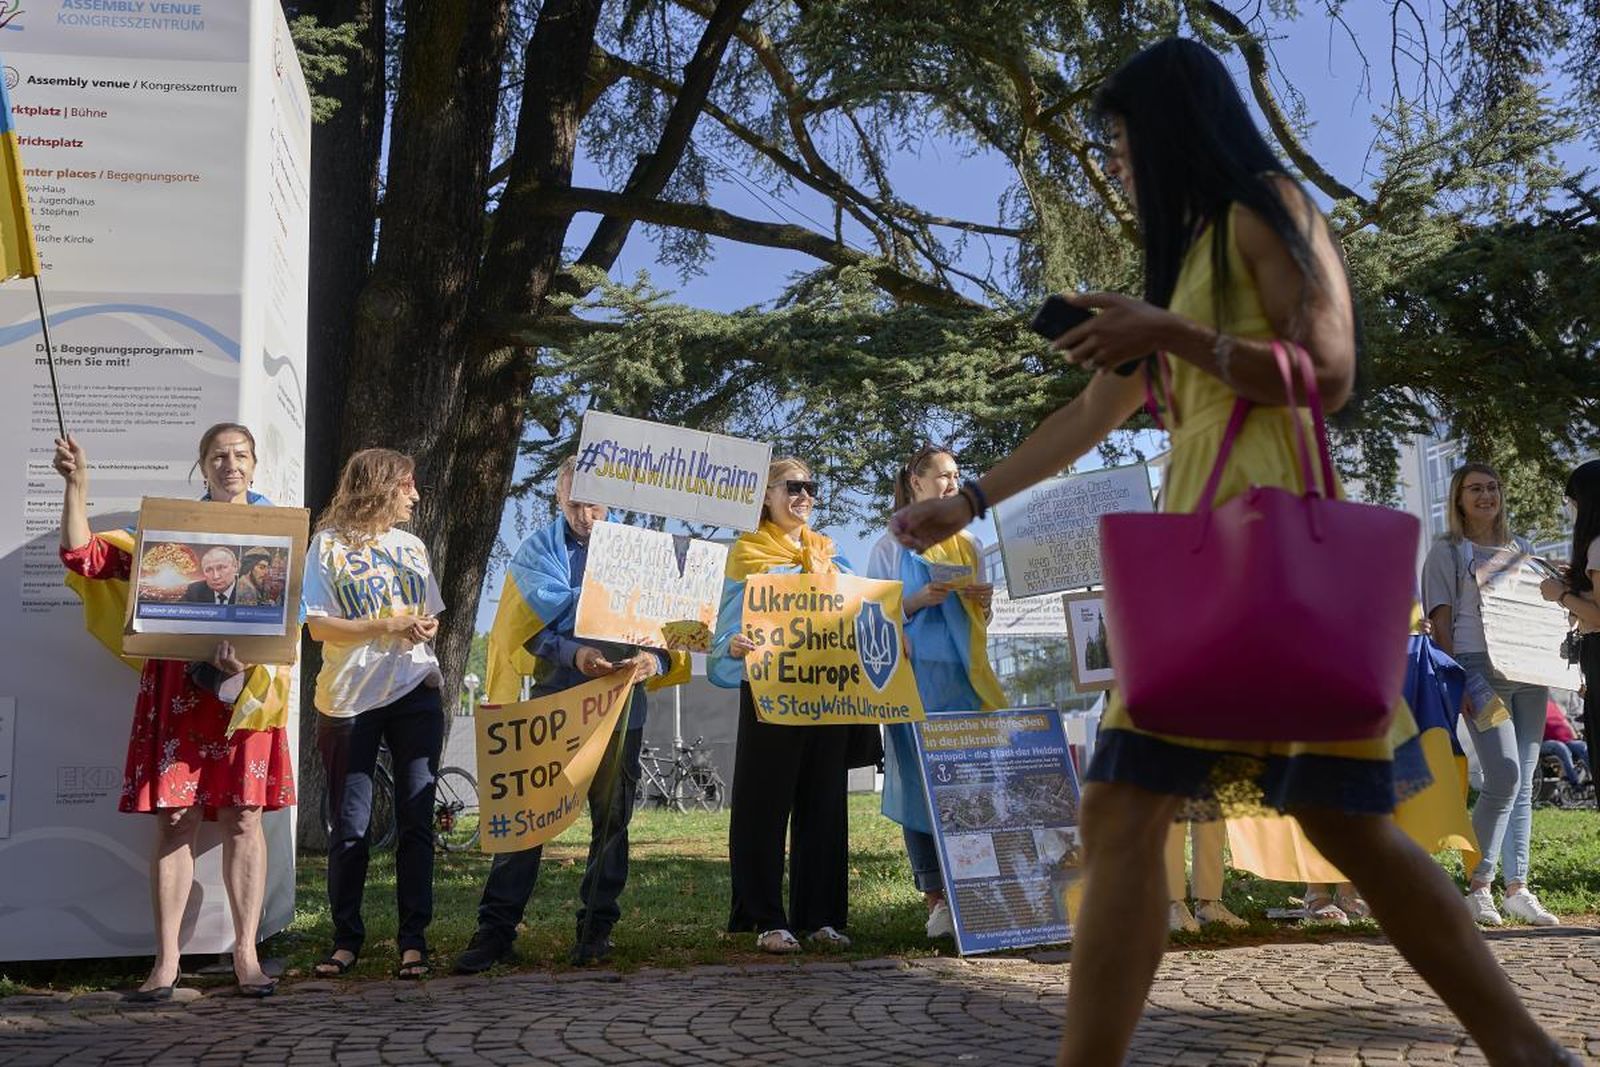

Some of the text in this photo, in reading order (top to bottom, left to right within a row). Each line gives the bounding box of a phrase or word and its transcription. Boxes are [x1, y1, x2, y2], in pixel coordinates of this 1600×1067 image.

[62, 0, 202, 15] ASSEMBLY VENUE
[58, 13, 205, 32] KONGRESSZENTRUM
[27, 76, 88, 89] Assembly
[92, 80, 130, 89] venue
[140, 81, 238, 93] Kongresszentrum
[11, 105, 62, 117] rktplatz
[71, 108, 108, 118] Bühne
[17, 136, 84, 149] drichsplatz
[23, 168, 54, 178] nter
[56, 169, 97, 180] places
[107, 170, 201, 182] Begegnungsorte
[39, 196, 96, 206] Jugendhaus
[40, 208, 80, 216] Stephan
[36, 234, 95, 244] lische Kirche
[61, 344, 194, 357] Begegnungsprogramm
[85, 357, 103, 367] Sie
[106, 357, 131, 368] mit!
[748, 586, 846, 613] Ukraine
[746, 616, 857, 652] is a Shield
[750, 651, 861, 692] of Europe
[759, 694, 912, 721] #StayWithUkraine
[487, 682, 626, 756] STOP PUT
[922, 717, 979, 734] Russische
[926, 737, 937, 748] in
[938, 735, 957, 747] der
[926, 749, 968, 764] Mariupol
[974, 750, 990, 760] die
[1033, 745, 1065, 756] Helden
[490, 760, 563, 801] STOP
